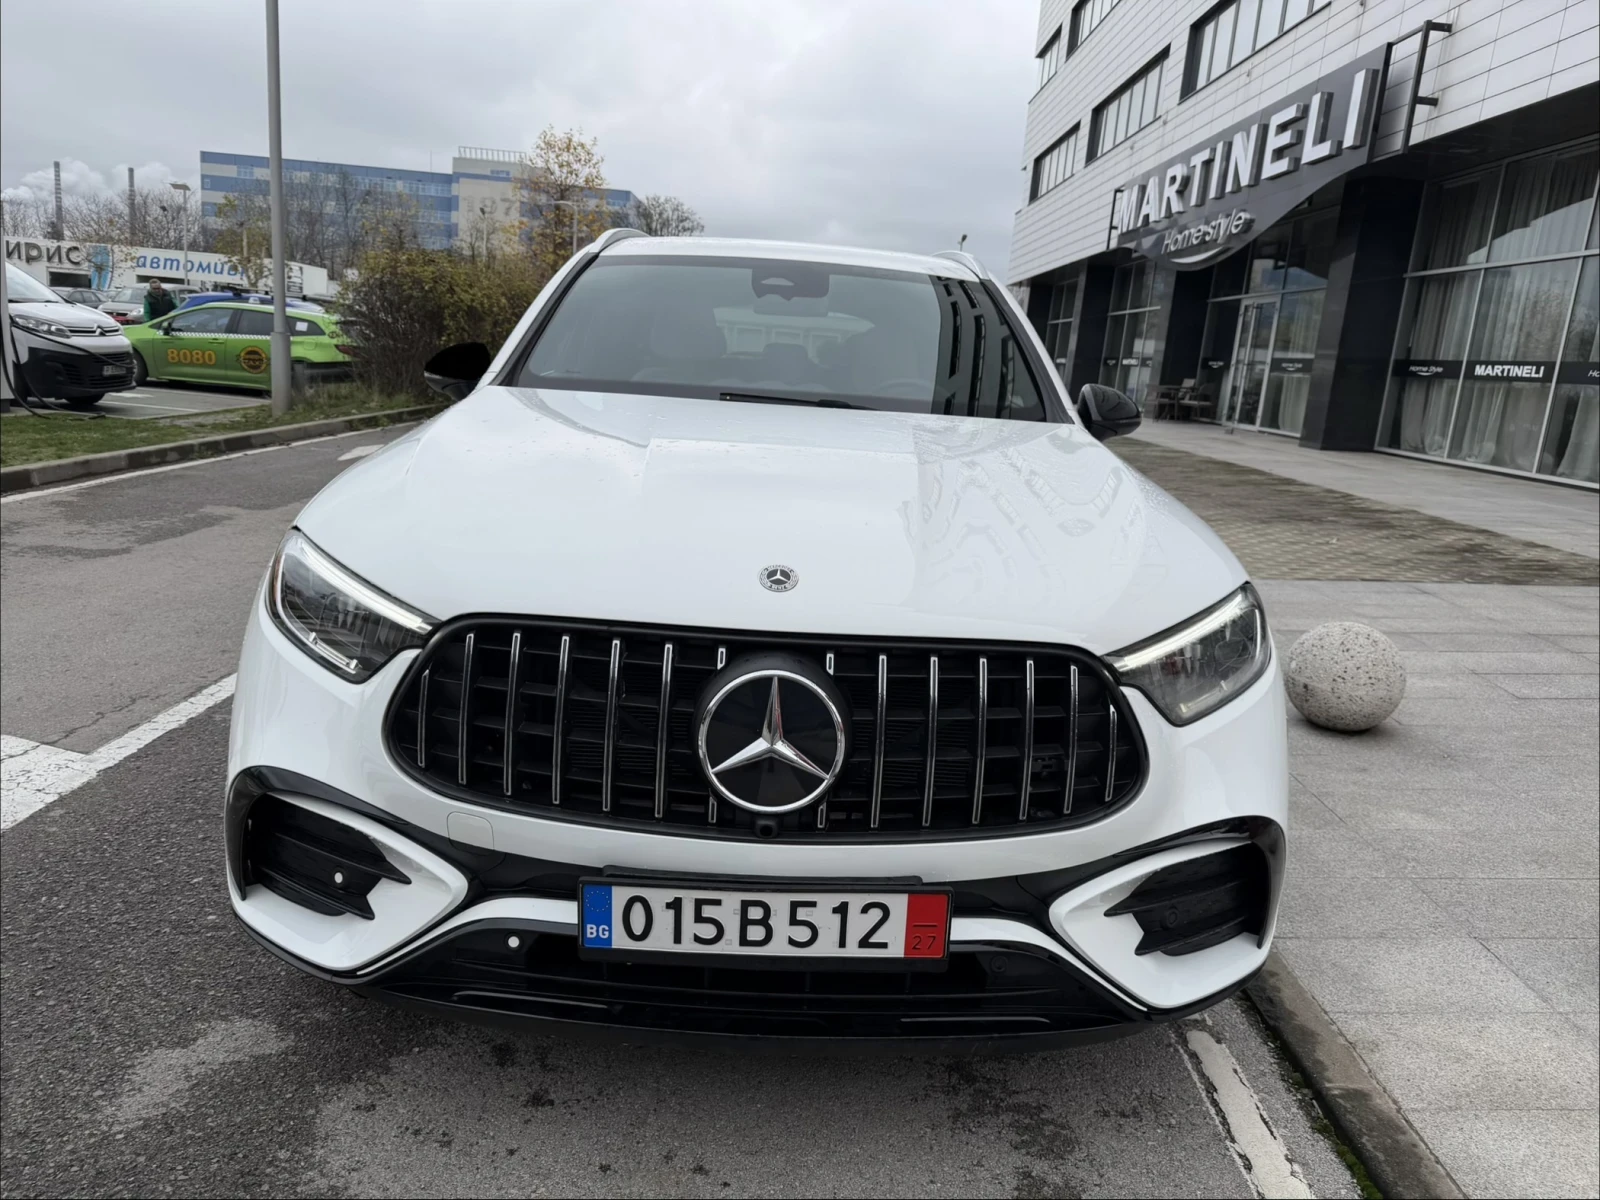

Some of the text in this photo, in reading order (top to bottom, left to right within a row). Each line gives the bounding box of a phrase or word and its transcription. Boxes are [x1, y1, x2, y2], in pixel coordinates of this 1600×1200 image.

[1117, 68, 1379, 236] MARTINELI
[136, 254, 246, 278] автомив
[167, 348, 216, 365] 8080
[1474, 364, 1545, 378] MARTINELI
[621, 894, 891, 949] 015B512
[586, 924, 610, 939] BG
[912, 934, 937, 951] 27
